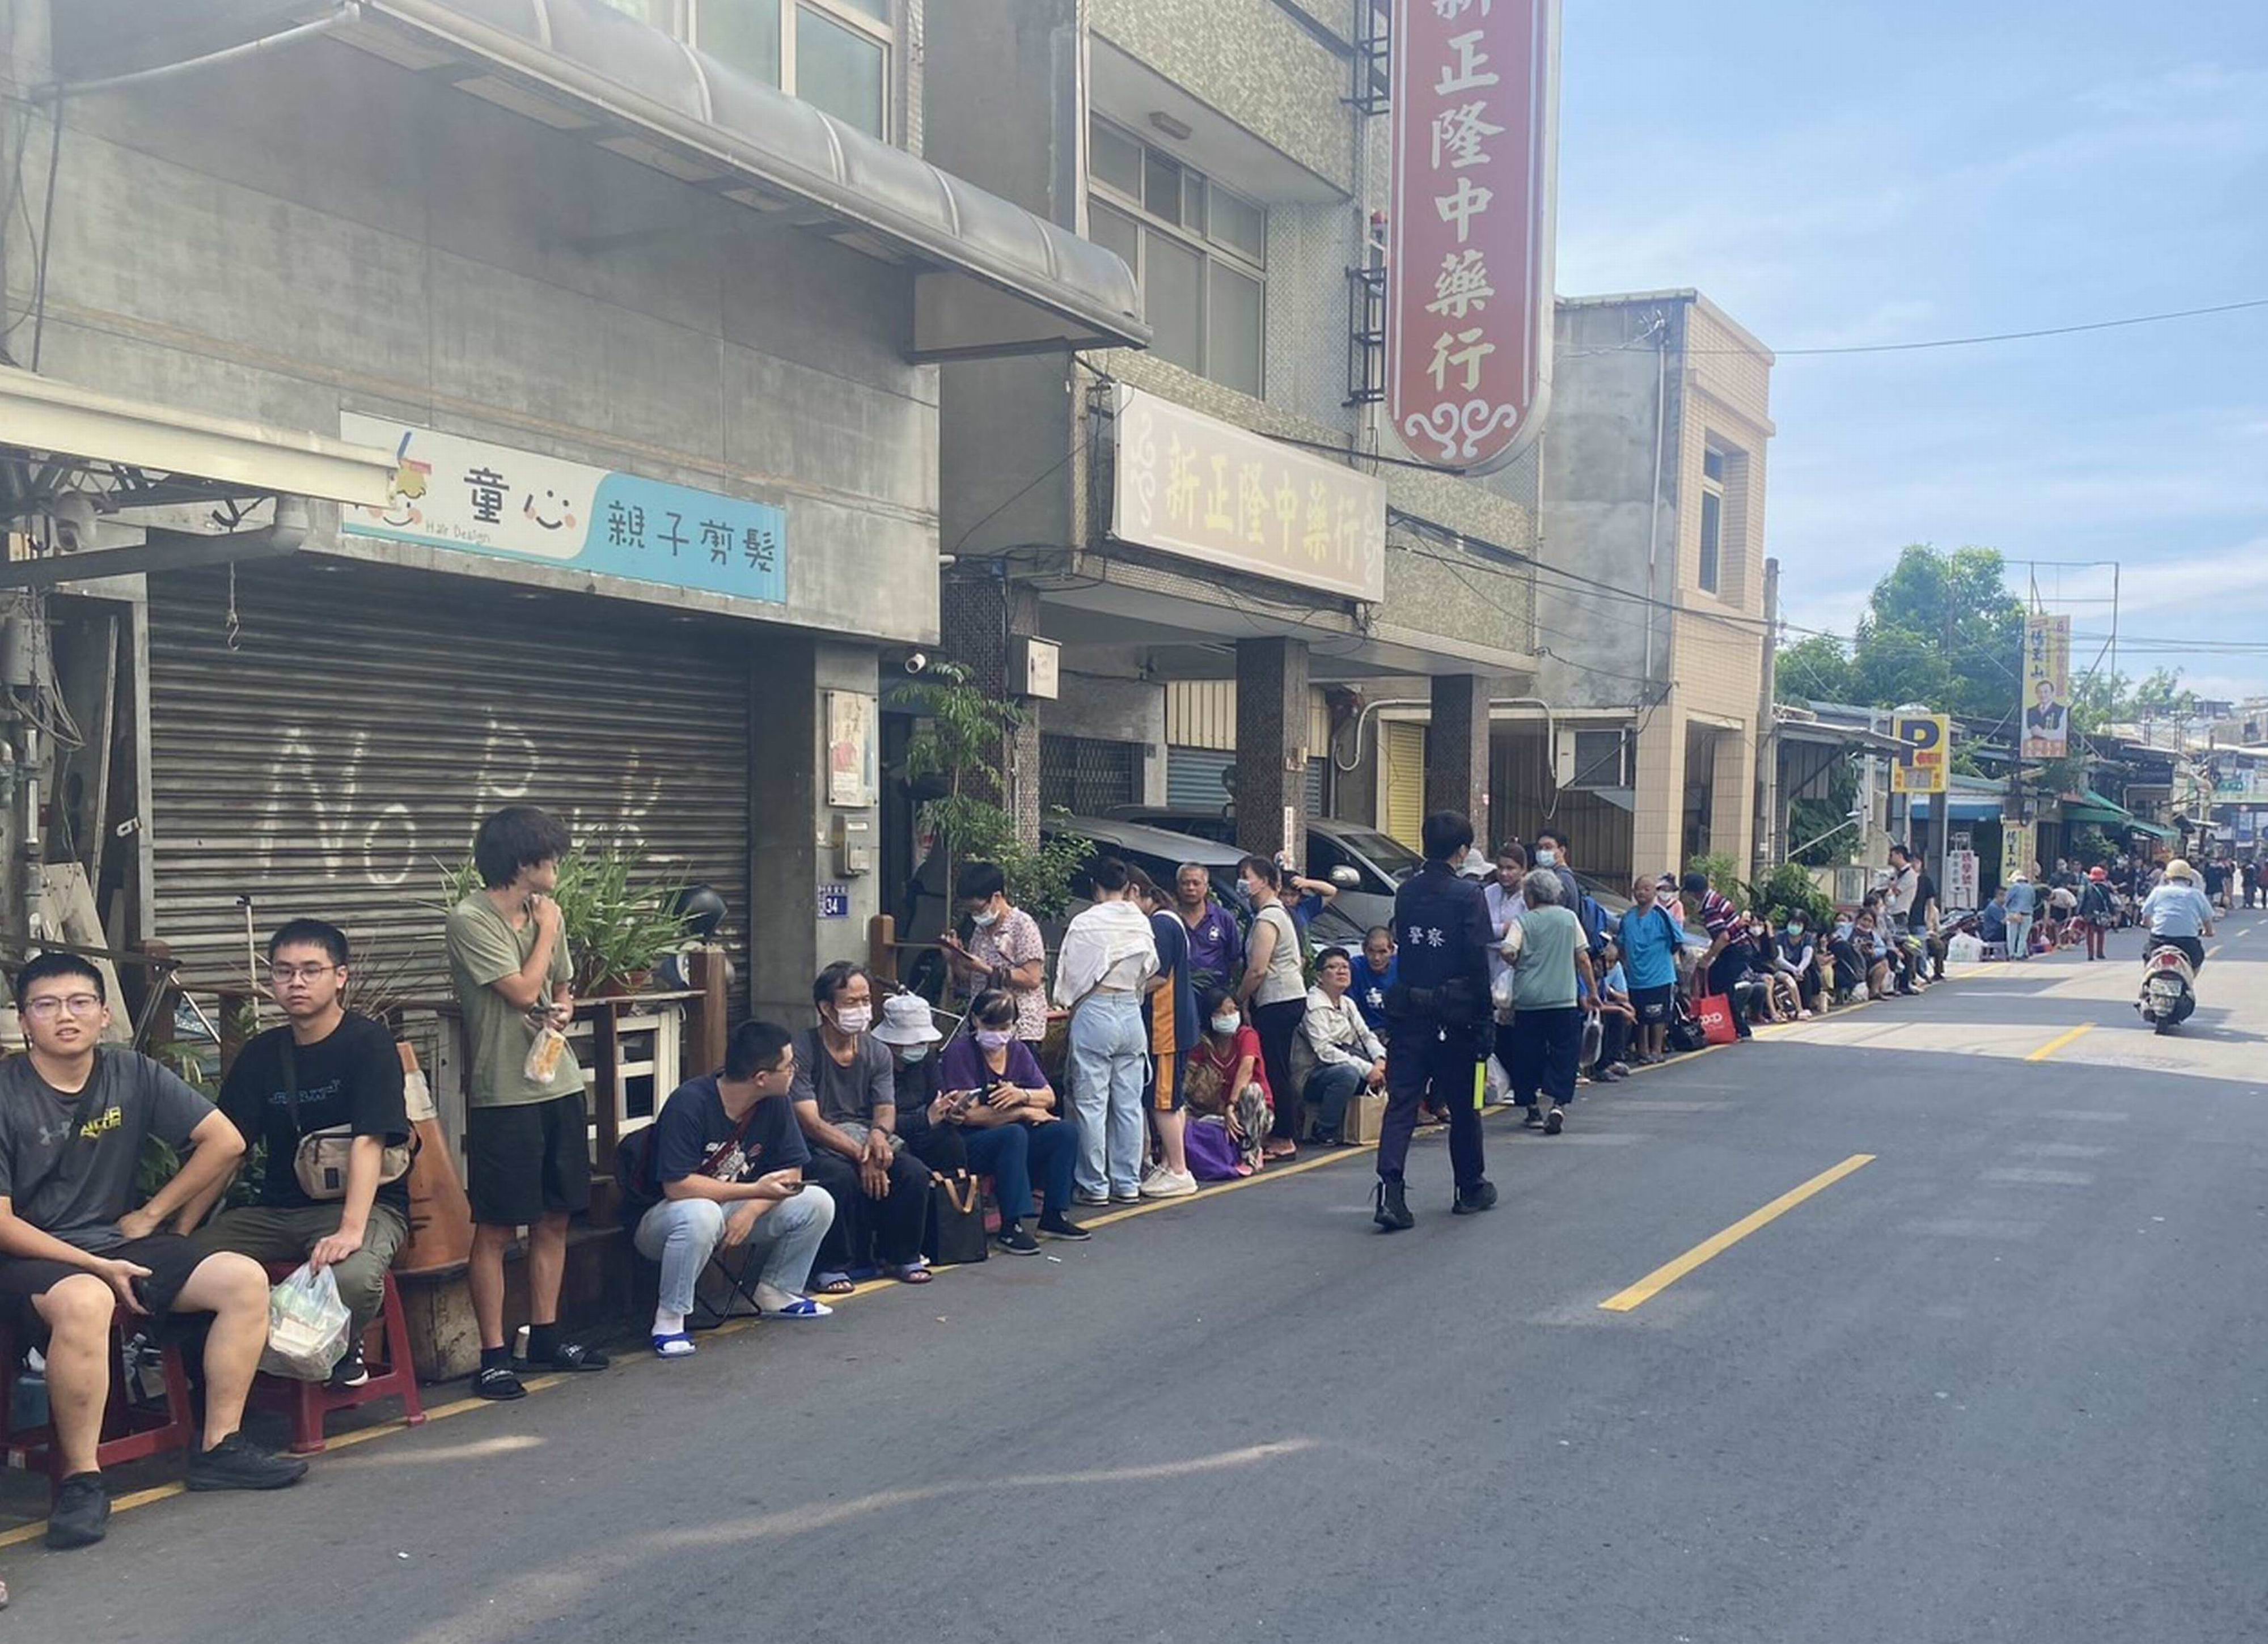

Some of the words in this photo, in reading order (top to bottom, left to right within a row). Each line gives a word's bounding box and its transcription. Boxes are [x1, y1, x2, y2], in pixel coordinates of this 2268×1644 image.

[1165, 430, 1360, 571] 新正隆中藥行
[425, 519, 449, 536] Hair
[454, 524, 491, 546] Design
[608, 499, 775, 573] 親子剪髮
[1899, 719, 1940, 766] P
[1408, 925, 1445, 947] 警察
